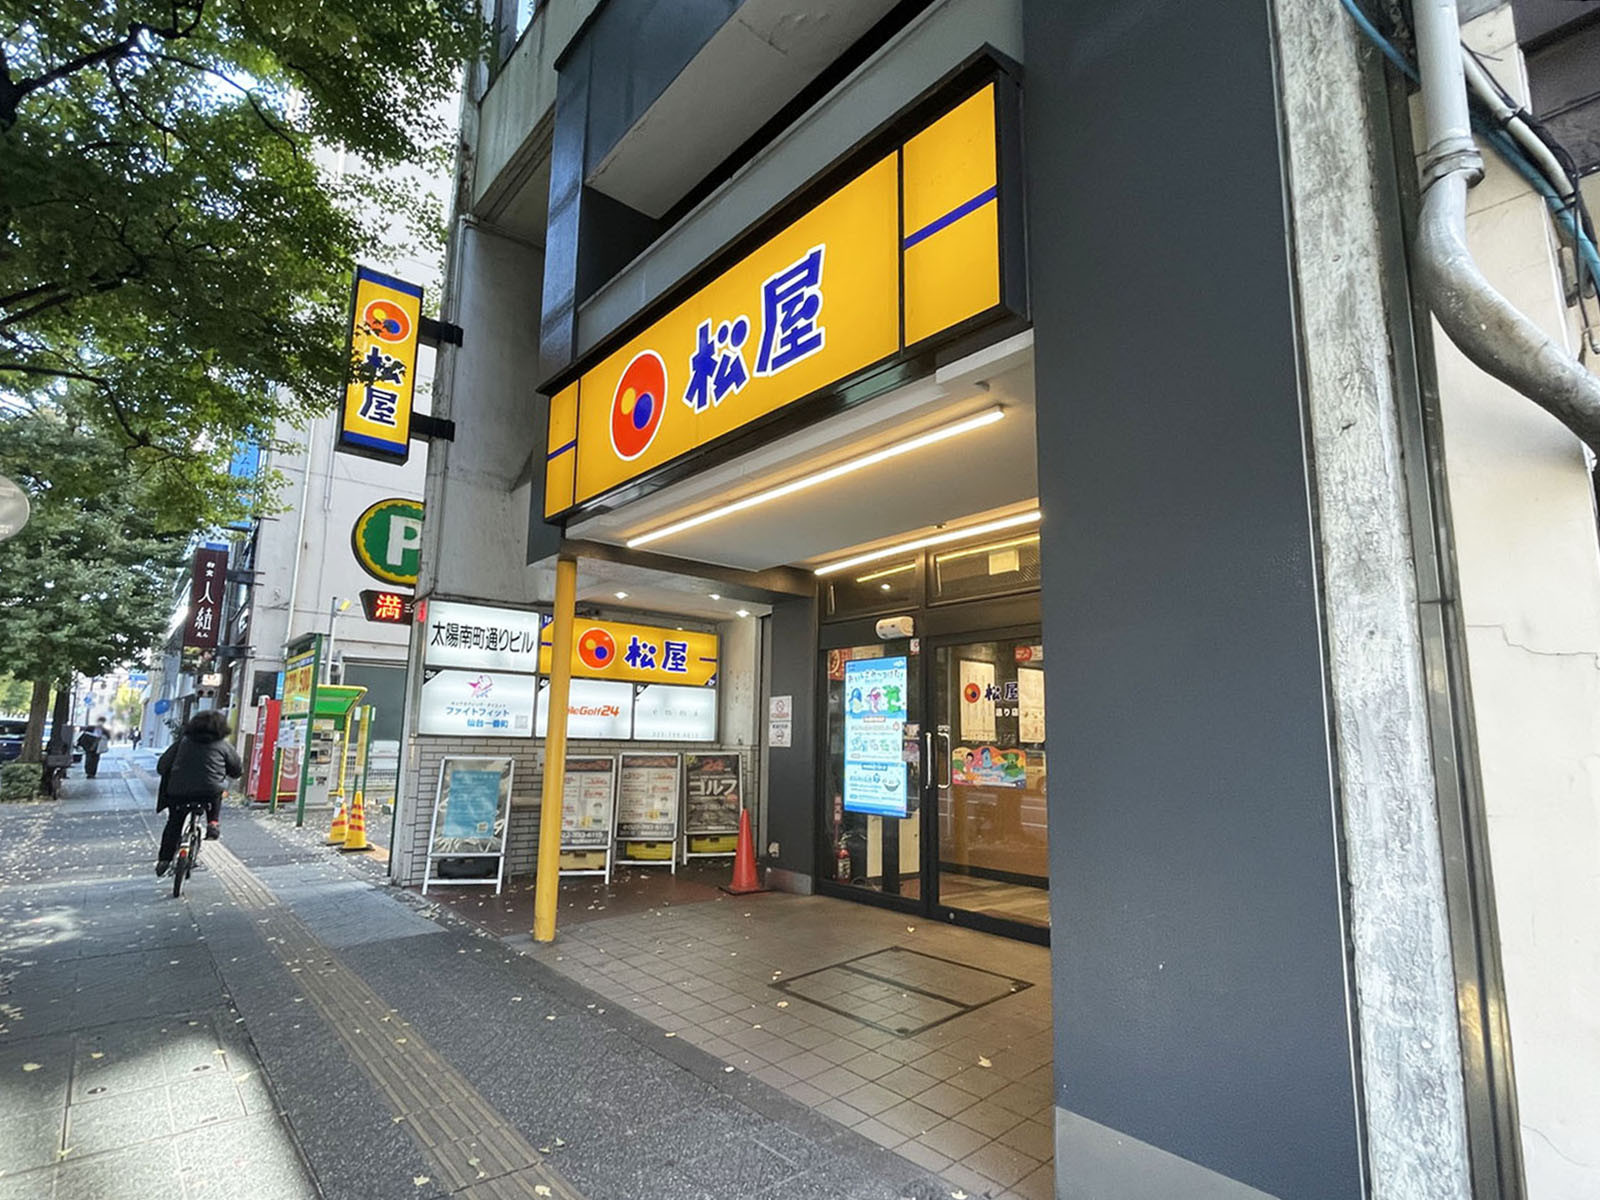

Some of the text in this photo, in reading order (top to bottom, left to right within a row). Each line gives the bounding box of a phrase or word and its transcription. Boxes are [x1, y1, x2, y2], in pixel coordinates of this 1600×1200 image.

[684, 247, 824, 411] 松屋
[359, 346, 407, 428] 松屋
[386, 514, 422, 566] P
[375, 593, 402, 620] 満
[430, 621, 534, 654] 太陽南町通りビル
[624, 637, 688, 673] 松屋
[985, 682, 1018, 701] 松屋
[446, 706, 510, 718] ファイトフィット
[689, 777, 738, 796] ゴルフ
